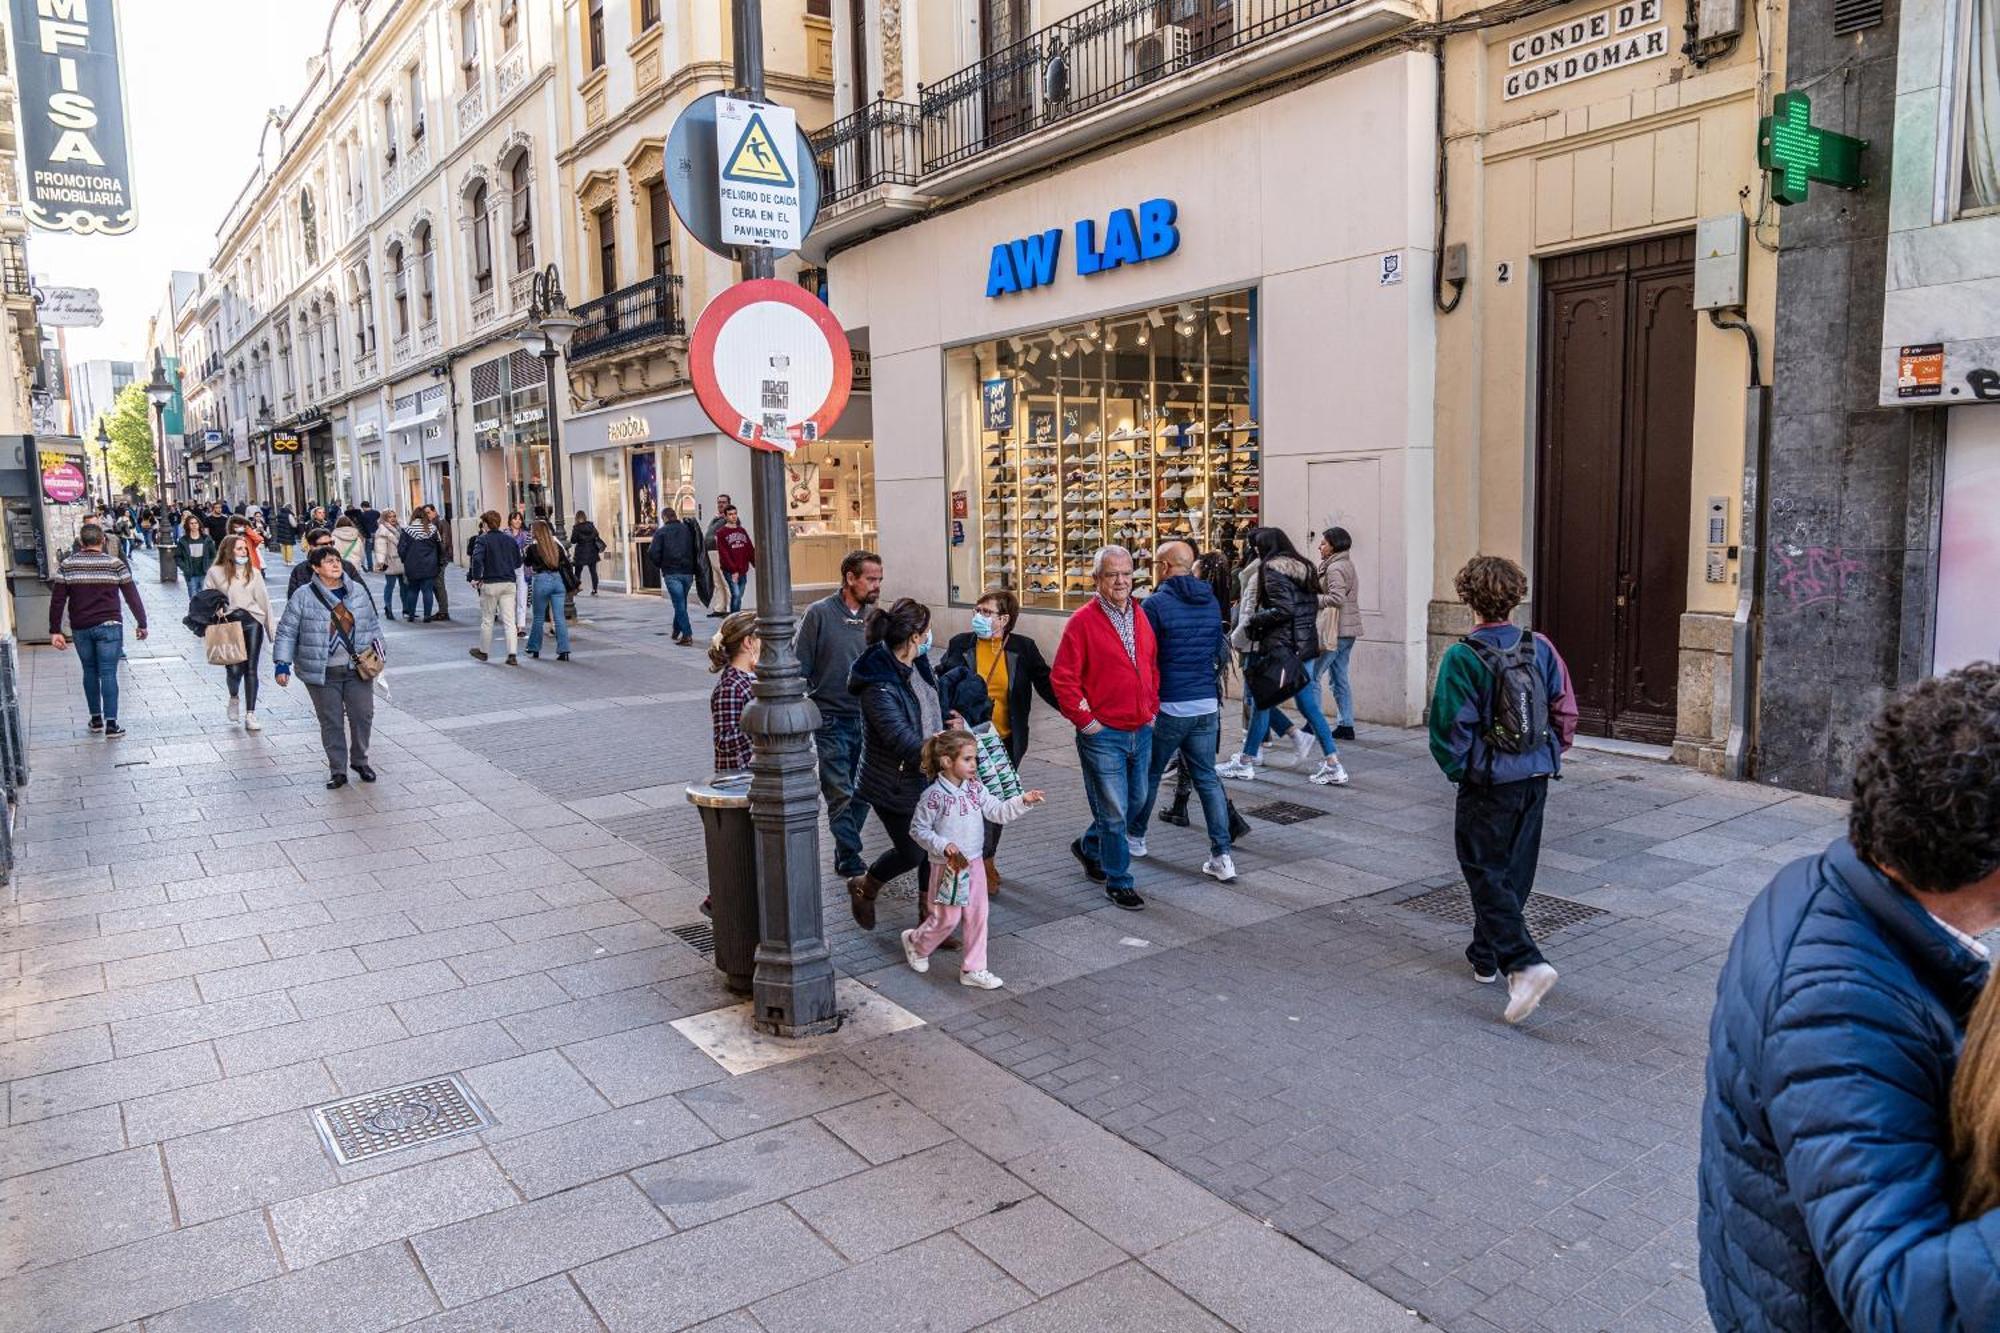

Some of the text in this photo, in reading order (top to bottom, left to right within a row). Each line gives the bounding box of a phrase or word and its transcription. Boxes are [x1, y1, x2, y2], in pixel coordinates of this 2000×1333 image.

[1512, 0, 1656, 62] CONDE DE
[1507, 31, 1664, 96] GONDOMAR
[34, 170, 123, 192] PROMOTORA
[36, 186, 125, 206] INMOBILIARIA
[720, 188, 758, 202] PELIGRO
[760, 192, 772, 204] DE
[731, 206, 790, 224] CERA EN EL
[734, 224, 789, 240] PAVIMENTO
[986, 198, 1181, 297] AW LAB
[1498, 263, 1509, 282] 2
[1520, 692, 1529, 734] Quechua
